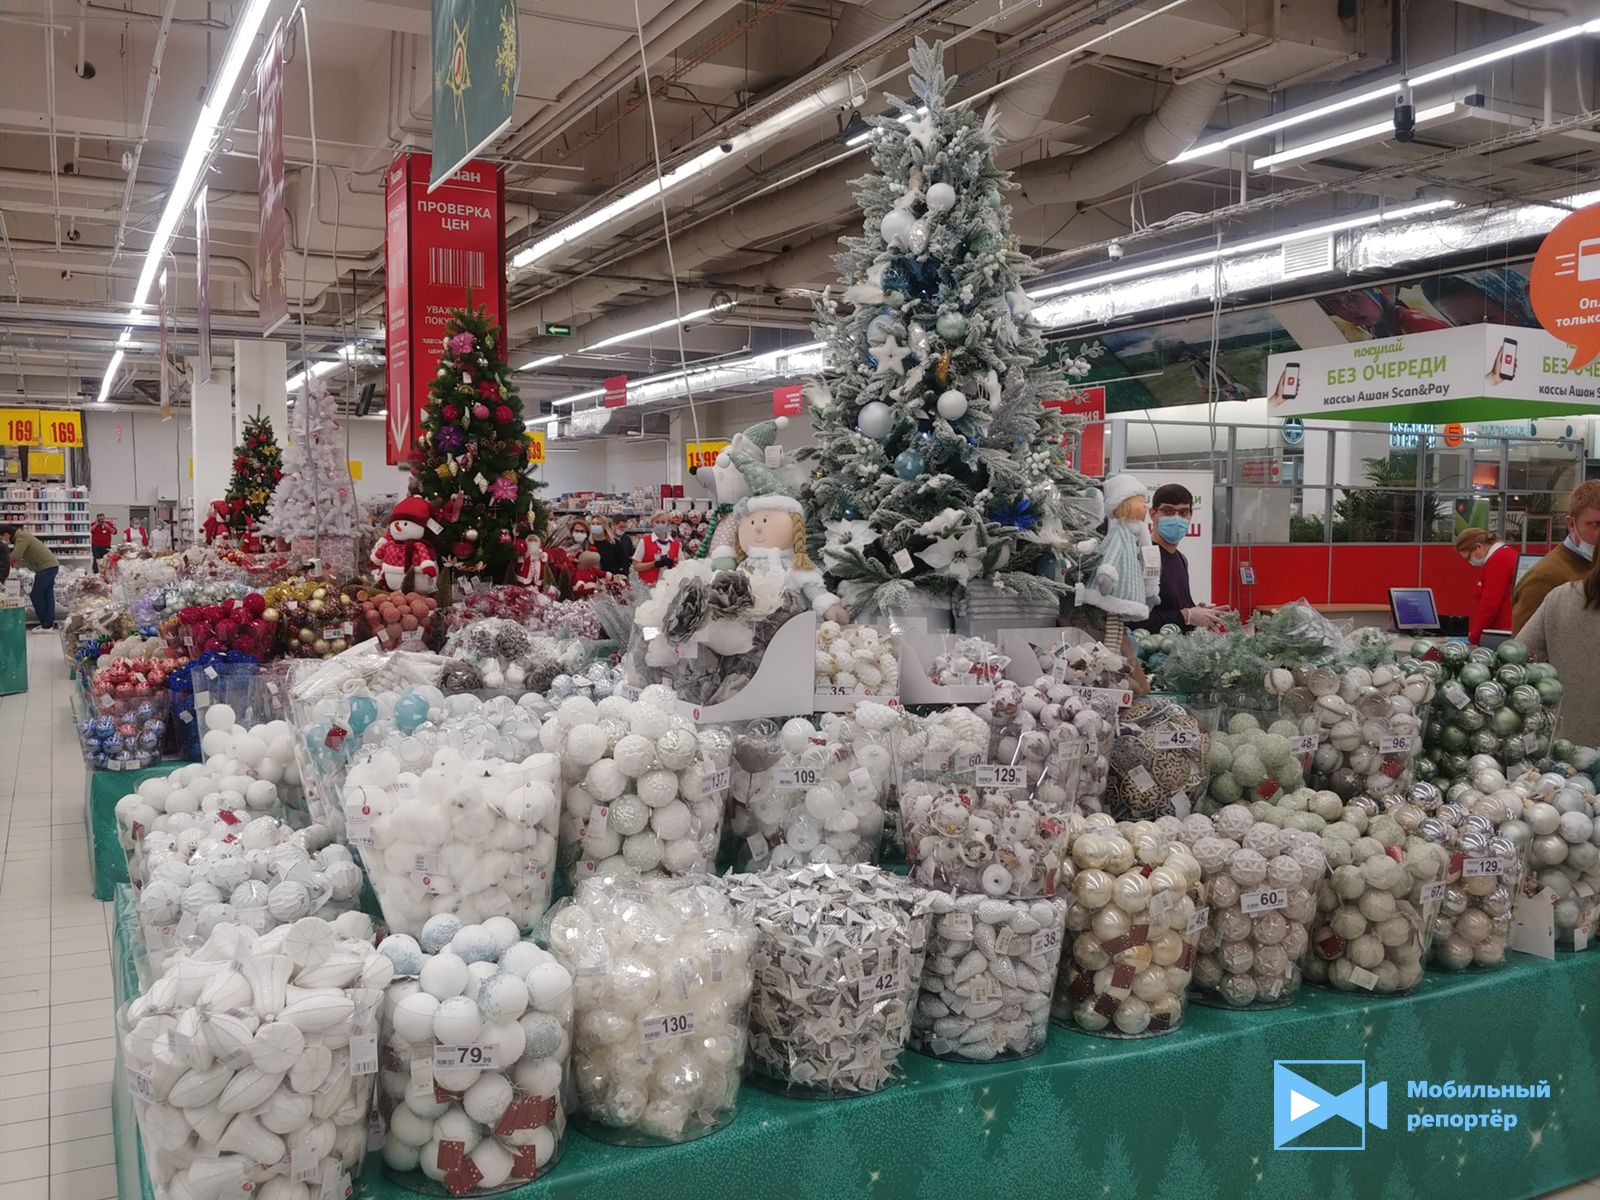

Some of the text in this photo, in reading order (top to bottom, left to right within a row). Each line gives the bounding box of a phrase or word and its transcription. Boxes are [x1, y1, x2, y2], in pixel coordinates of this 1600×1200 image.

[417, 200, 492, 219] ПРОВЕРКА
[441, 217, 470, 231] ЦЕН
[1354, 338, 1405, 363] покупай
[1327, 354, 1447, 386] БЕЗ ОЧЕРЕДИ
[1542, 356, 1569, 375] БЕЗ
[1323, 383, 1450, 406] кассы Ашан Scan&Pay
[1539, 385, 1595, 398] кассы Ашан
[8, 420, 33, 441] 169
[51, 421, 76, 443] 169
[1170, 732, 1186, 744] 45
[1392, 737, 1406, 749] 96
[969, 754, 981, 768] 60
[794, 770, 816, 783] 109
[994, 768, 1016, 782] 129
[1480, 860, 1498, 872] 129
[1260, 891, 1278, 905] 60
[1043, 931, 1056, 947] 38
[875, 974, 893, 990] 42
[662, 1015, 687, 1033] 130
[457, 1047, 482, 1063] 79
